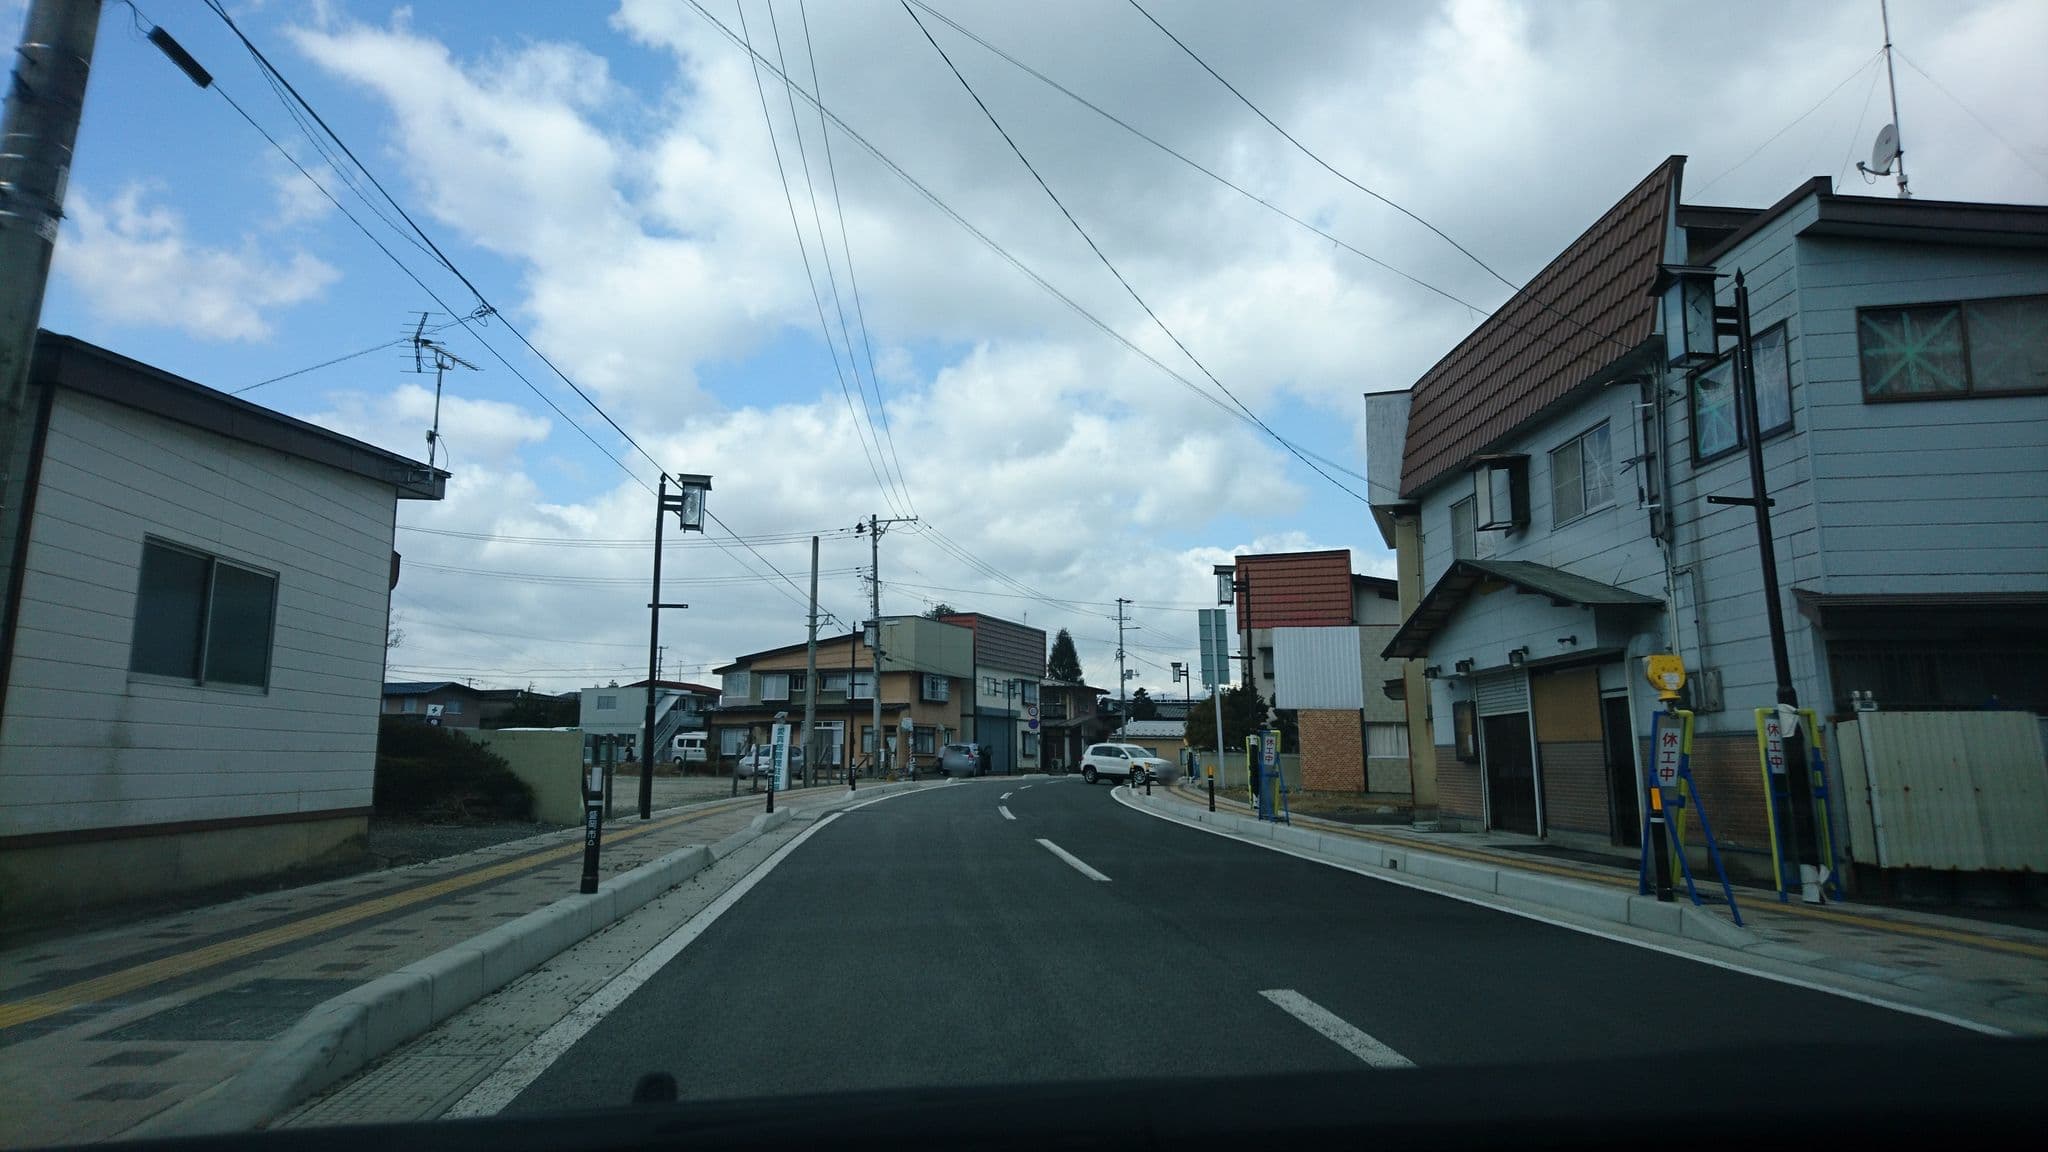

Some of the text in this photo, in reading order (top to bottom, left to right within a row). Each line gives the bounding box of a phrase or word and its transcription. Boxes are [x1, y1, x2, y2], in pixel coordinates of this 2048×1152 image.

[1265, 738, 1274, 763] 休工中
[1660, 731, 1678, 782] 休工中
[1767, 723, 1783, 768] 休工中
